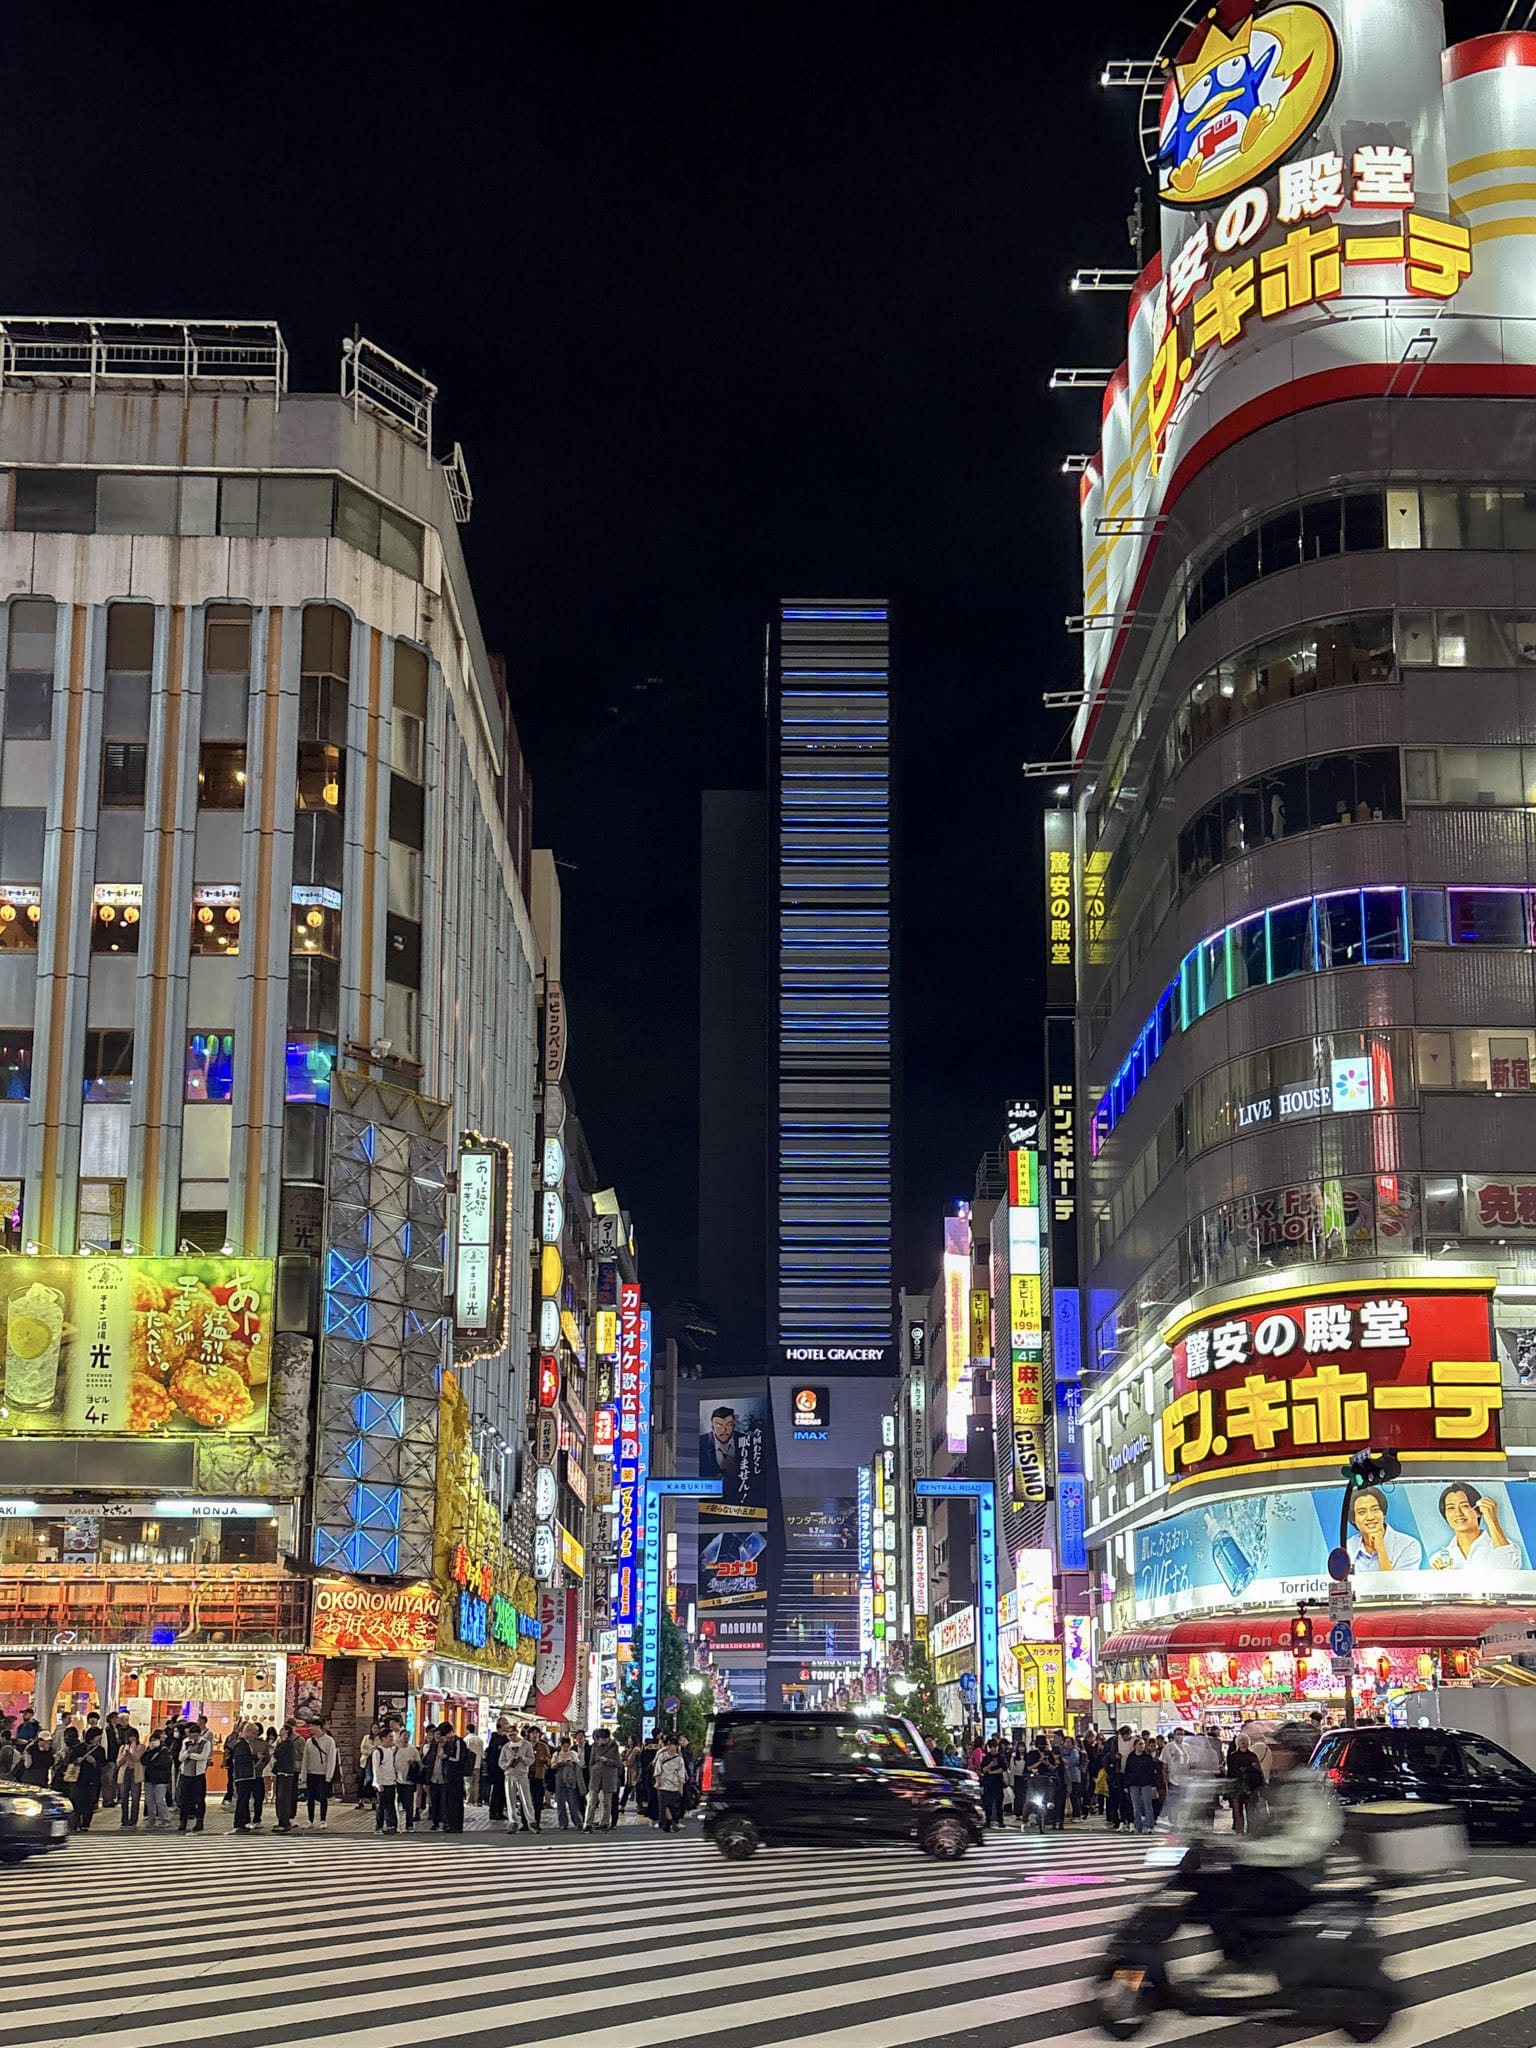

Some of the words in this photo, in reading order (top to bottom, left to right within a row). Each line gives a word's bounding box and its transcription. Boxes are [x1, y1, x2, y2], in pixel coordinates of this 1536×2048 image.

[1152, 145, 1416, 350] 安の殿堂
[1148, 213, 1472, 477] ン.キホーテ
[1050, 851, 1072, 964] 驚安の殿堂
[1238, 1098, 1272, 1126] LIVE
[1279, 1085, 1331, 1114] HOUSE
[174, 1275, 199, 1346] チキンが
[466, 1301, 478, 1316] 光
[1018, 1279, 1029, 1318] 生ビール
[90, 1344, 111, 1369] 光
[145, 1308, 170, 1372] たべたい。
[200, 1305, 232, 1377] 猛烈に
[786, 1348, 826, 1360] HOTEL
[827, 1348, 884, 1360] GRACERY
[1018, 1351, 1037, 1361] 4F
[1184, 1299, 1411, 1380] 驚安の殿堂
[1017, 1365, 1039, 1406] 麻雀
[85, 1405, 109, 1425] 4F
[1162, 1361, 1503, 1475] ドン.キホーテ
[794, 1431, 828, 1440] IMAX
[1109, 1453, 1122, 1474] Don
[1122, 1434, 1148, 1464] Quijote
[1015, 1429, 1044, 1497] CASINO
[192, 1506, 238, 1515] MONJA
[646, 1512, 658, 1617] GODZILLA
[716, 1560, 758, 1577] コナン
[317, 1591, 441, 1617] OKONOMIYAKI
[1279, 1578, 1328, 1594] Torride
[324, 1615, 432, 1640] お好み焼き
[1238, 1633, 1272, 1647] Don
[645, 1628, 657, 1679] ROAD
